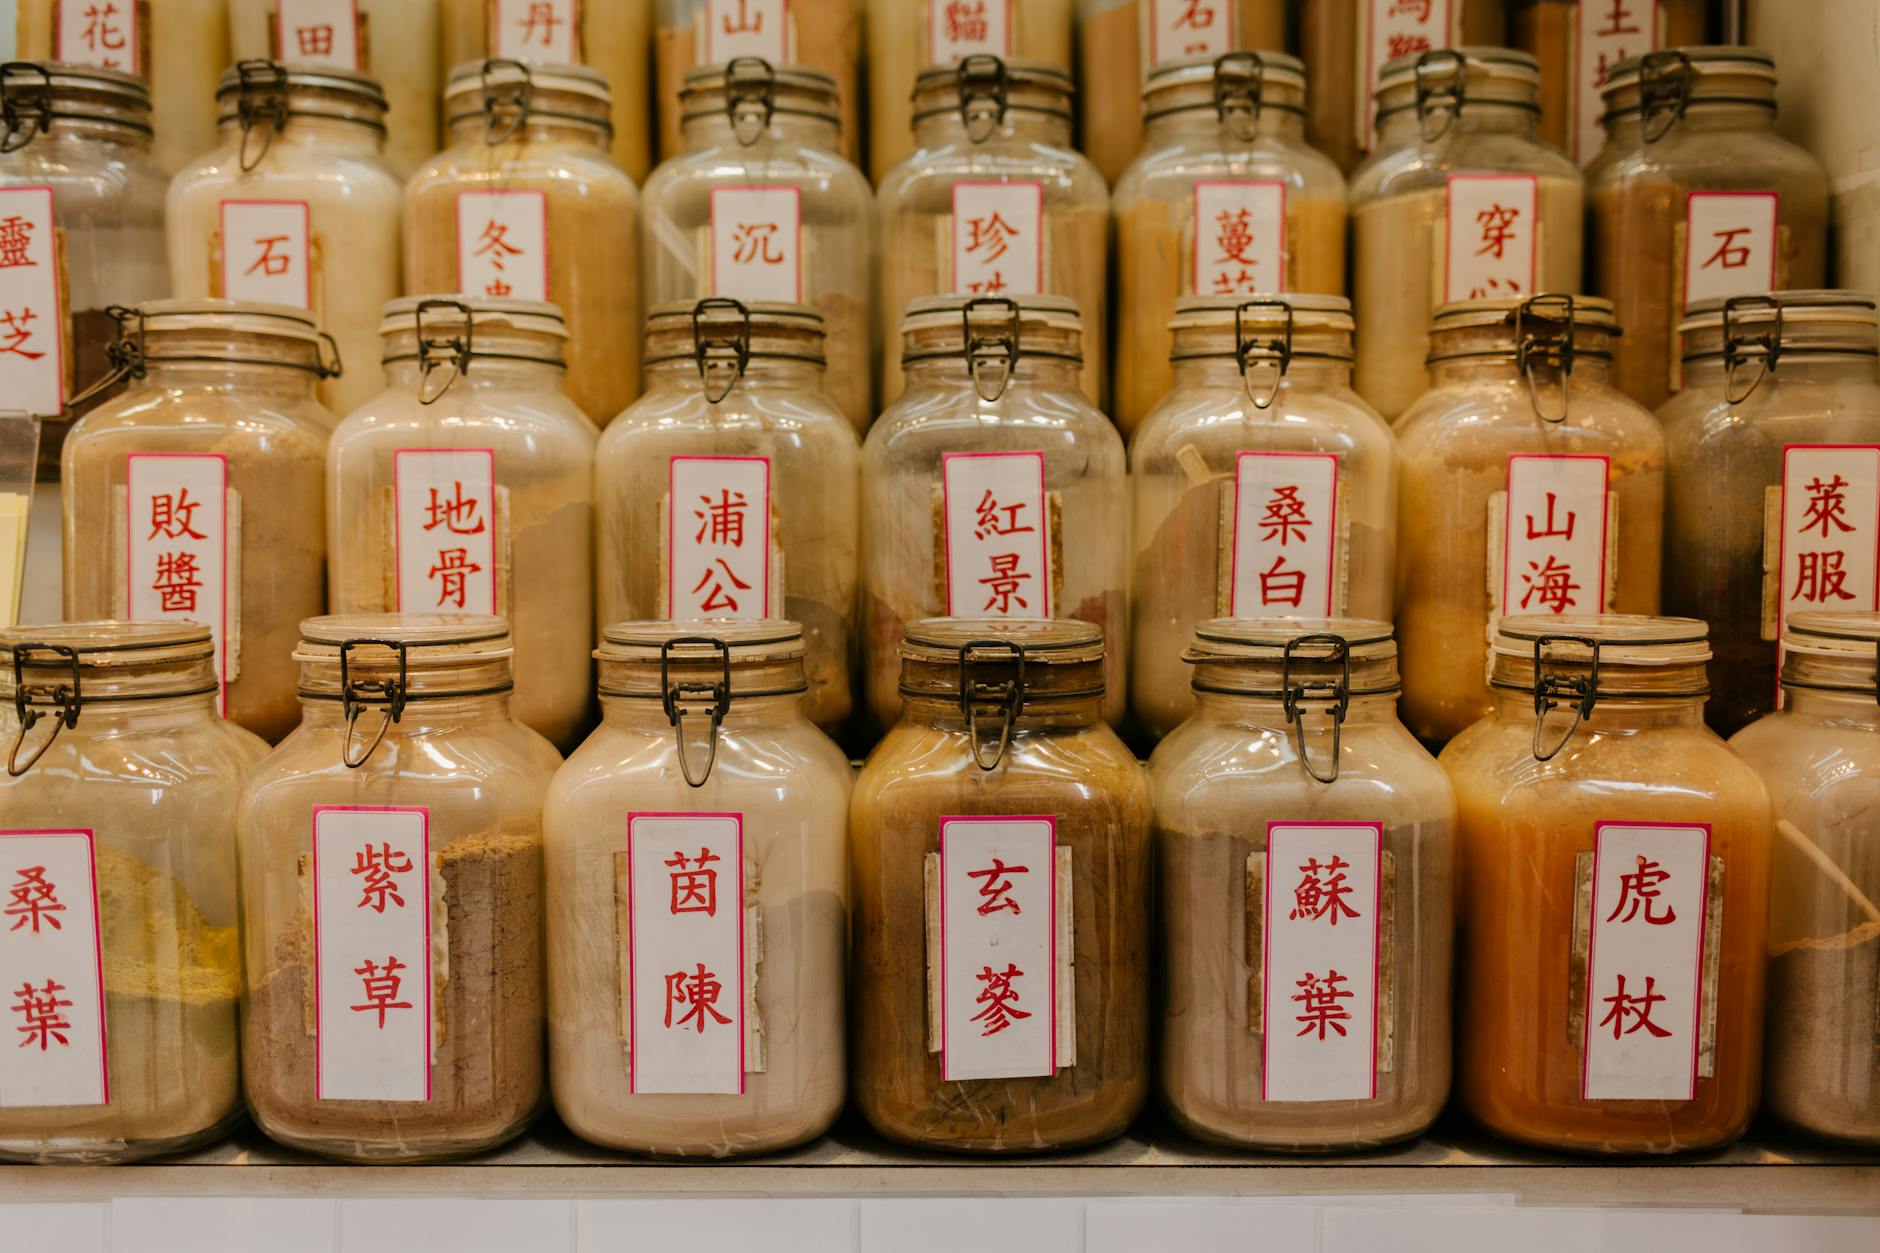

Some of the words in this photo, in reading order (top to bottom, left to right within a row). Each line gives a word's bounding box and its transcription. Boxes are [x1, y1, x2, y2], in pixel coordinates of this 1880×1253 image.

[80, 6, 126, 69] 花
[1171, 0, 1216, 55] 石
[248, 235, 290, 277] 石
[732, 223, 785, 265] 沉
[1703, 226, 1753, 270] 石
[423, 480, 485, 608] 地骨
[975, 490, 1035, 614] 紅景
[1258, 485, 1313, 608] 桑白
[1520, 491, 1581, 617] 山海
[1791, 474, 1857, 603] 萊服
[4, 865, 73, 1051] 桑葉
[351, 841, 414, 1029] 紫草
[663, 847, 732, 1033] 茵陳
[967, 857, 1032, 1038] 玄蔘
[1288, 854, 1361, 1041] 蘇葉
[1599, 855, 1677, 1041] 虎杖
